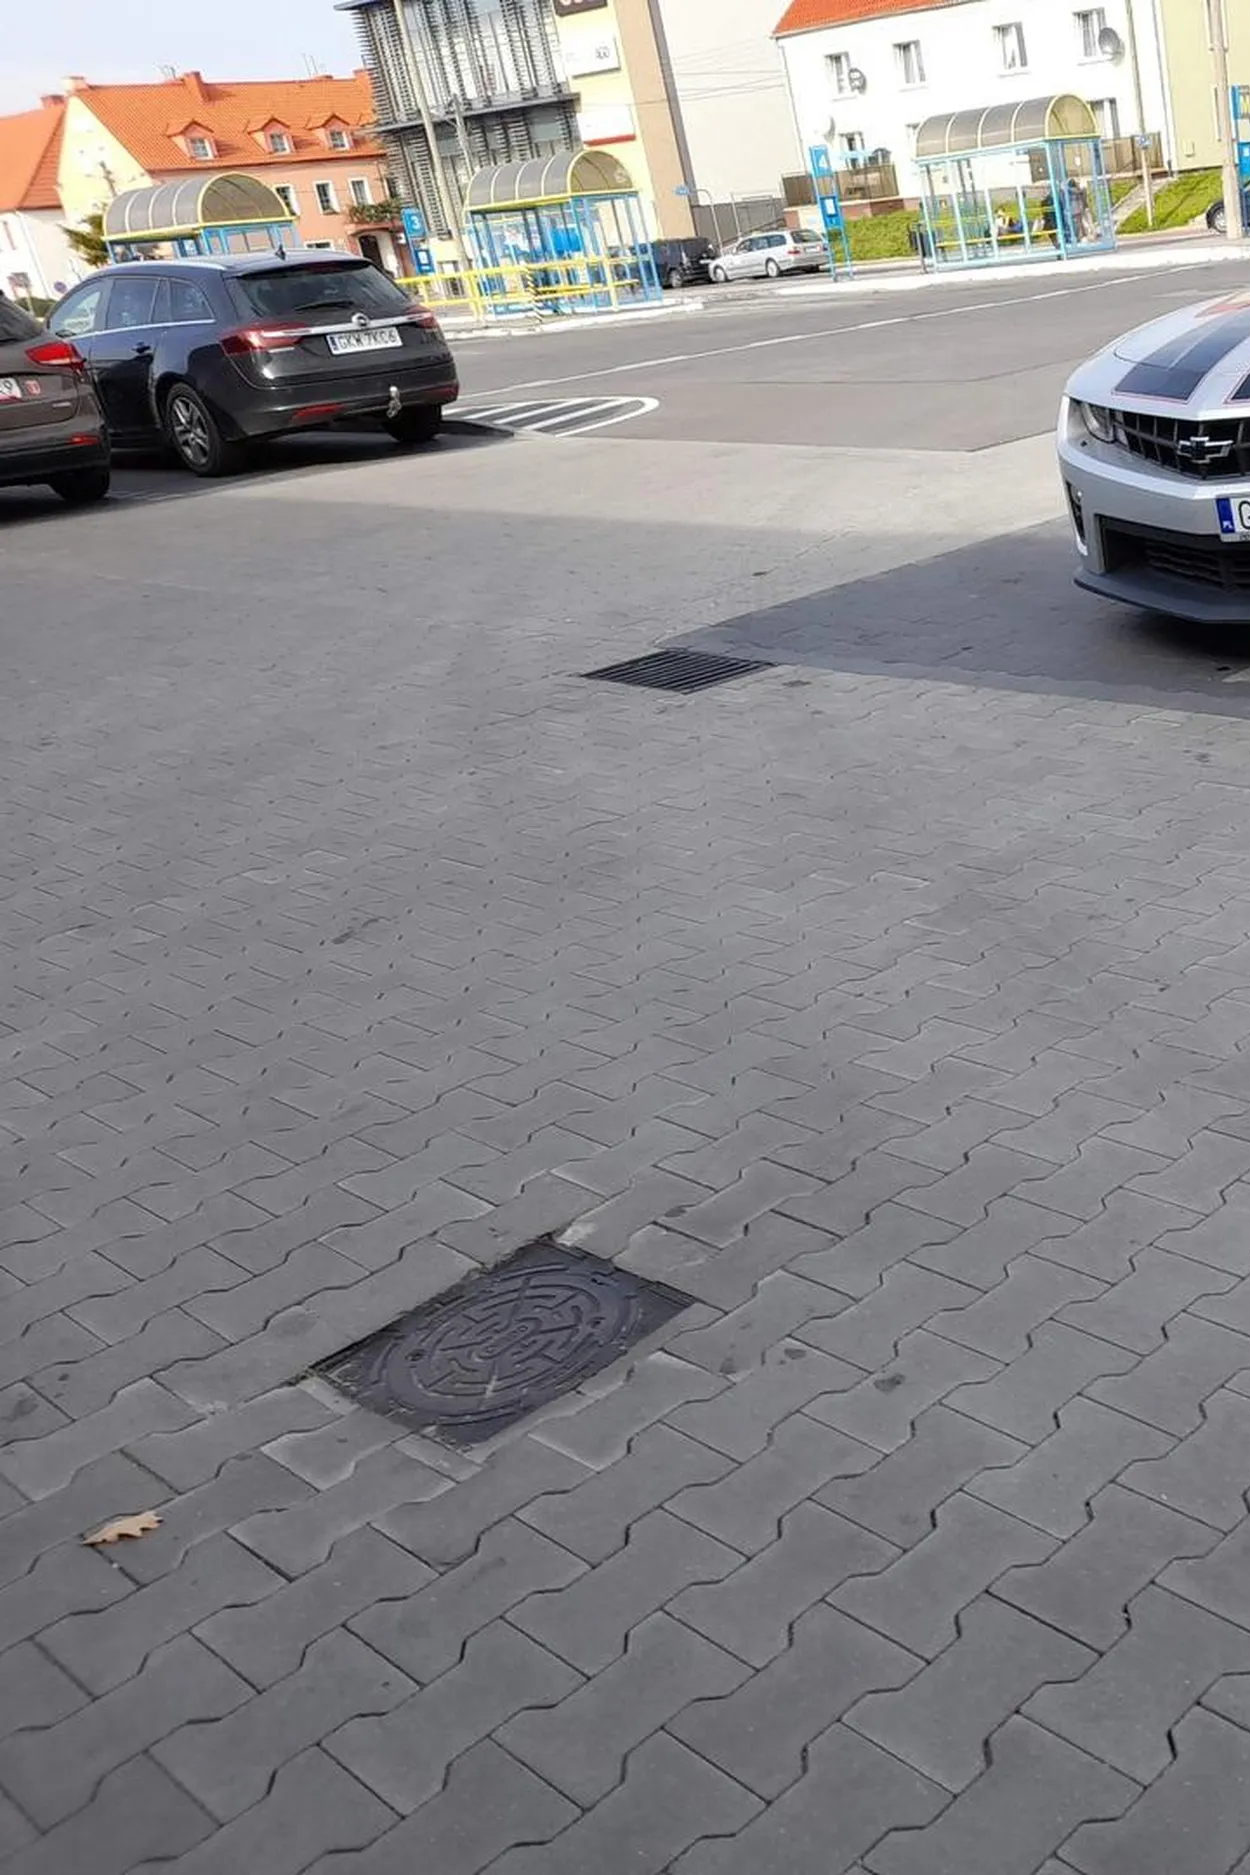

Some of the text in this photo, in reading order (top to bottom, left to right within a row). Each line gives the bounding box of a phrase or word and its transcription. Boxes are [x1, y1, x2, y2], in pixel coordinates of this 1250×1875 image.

[411, 215, 421, 230] 3
[338, 331, 363, 349] GKW
[1222, 520, 1233, 529] PL
